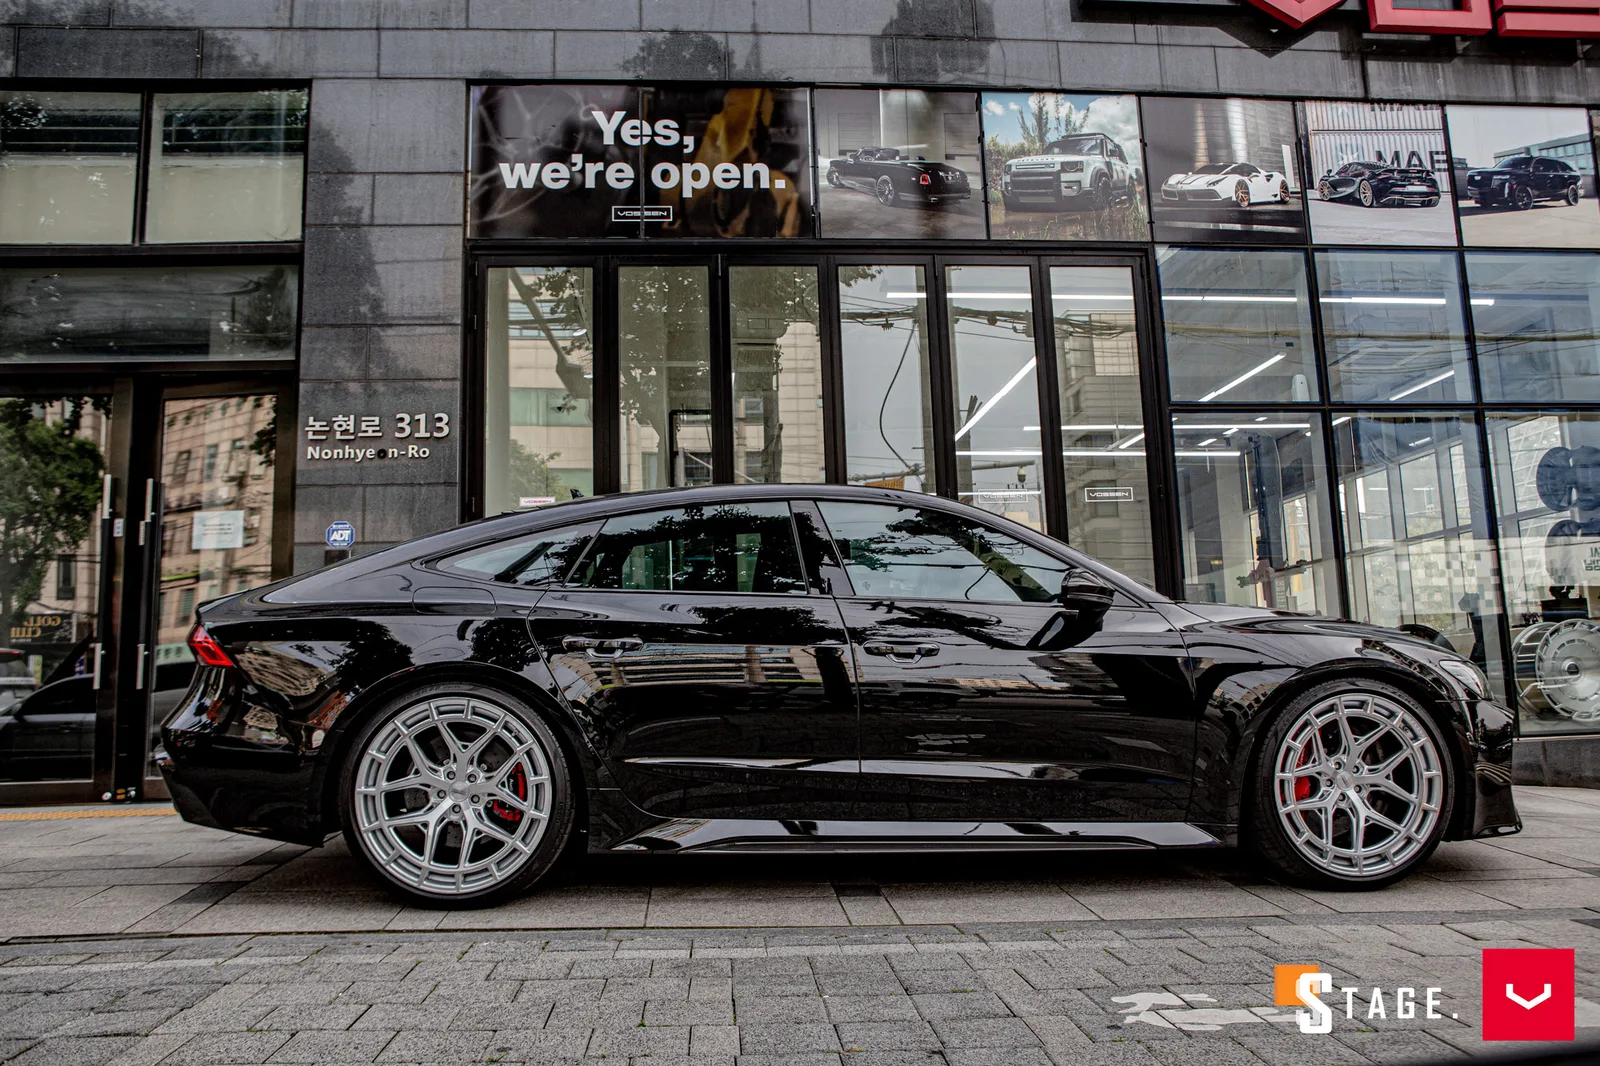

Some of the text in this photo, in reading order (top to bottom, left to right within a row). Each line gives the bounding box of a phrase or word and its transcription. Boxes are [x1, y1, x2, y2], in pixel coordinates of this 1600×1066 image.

[591, 110, 695, 154] Yes,
[651, 161, 787, 199] open.
[304, 412, 451, 441] 논현로 313
[330, 530, 351, 541] ADT
